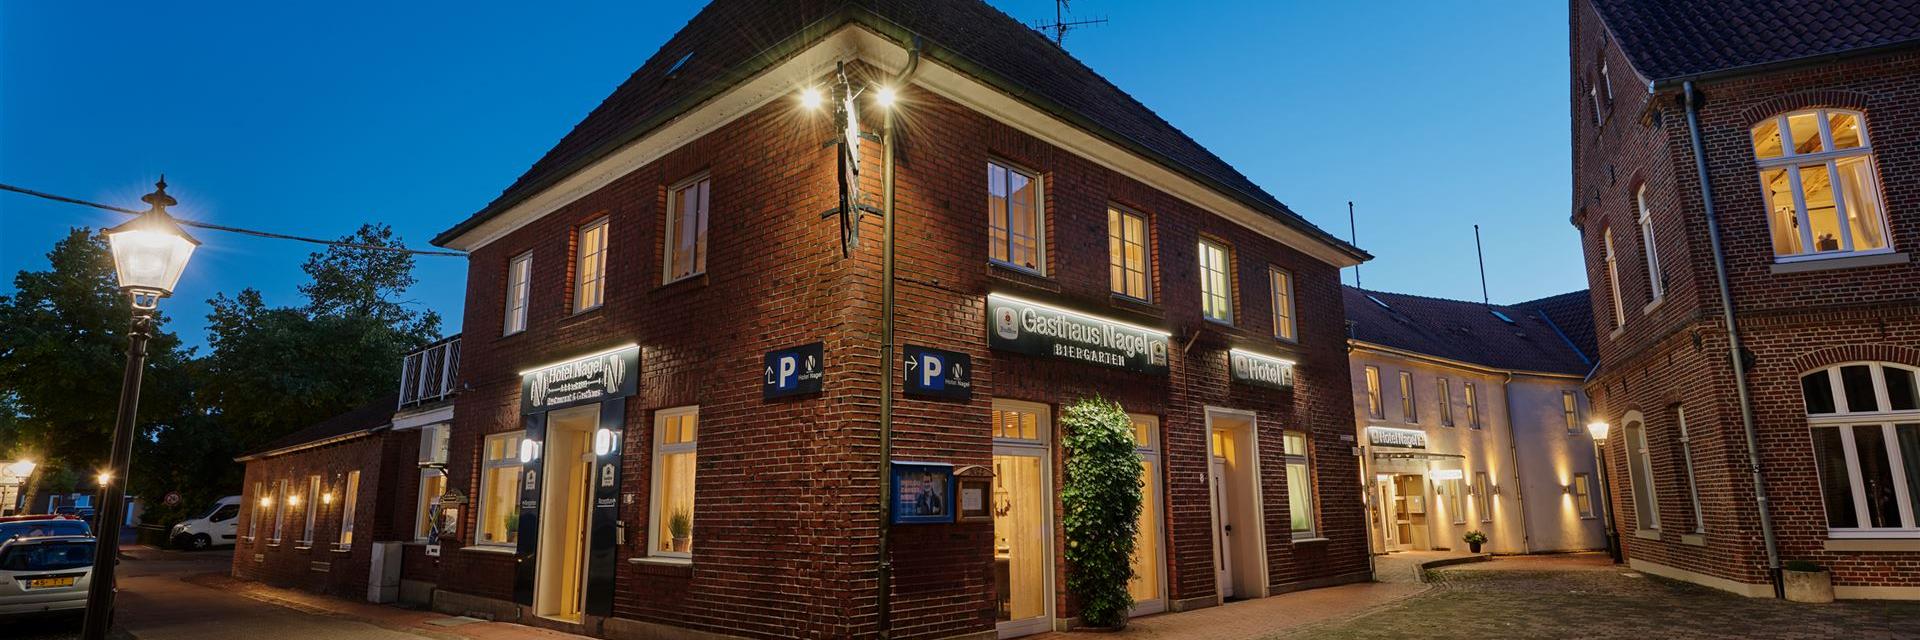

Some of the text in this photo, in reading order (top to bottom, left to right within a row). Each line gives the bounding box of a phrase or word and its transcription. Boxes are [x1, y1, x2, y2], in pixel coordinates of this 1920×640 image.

[1021, 306, 1148, 358] Gasthaus Nagel
[1055, 343, 1125, 367] BIERGARTEN
[549, 356, 603, 384] Hotel Nagel
[780, 356, 796, 388] P
[810, 371, 823, 380] Nagel
[923, 355, 942, 386] P
[1248, 358, 1281, 386] Hotel
[957, 380, 970, 389] Nagel
[1379, 430, 1418, 447] Hotel Nagel
